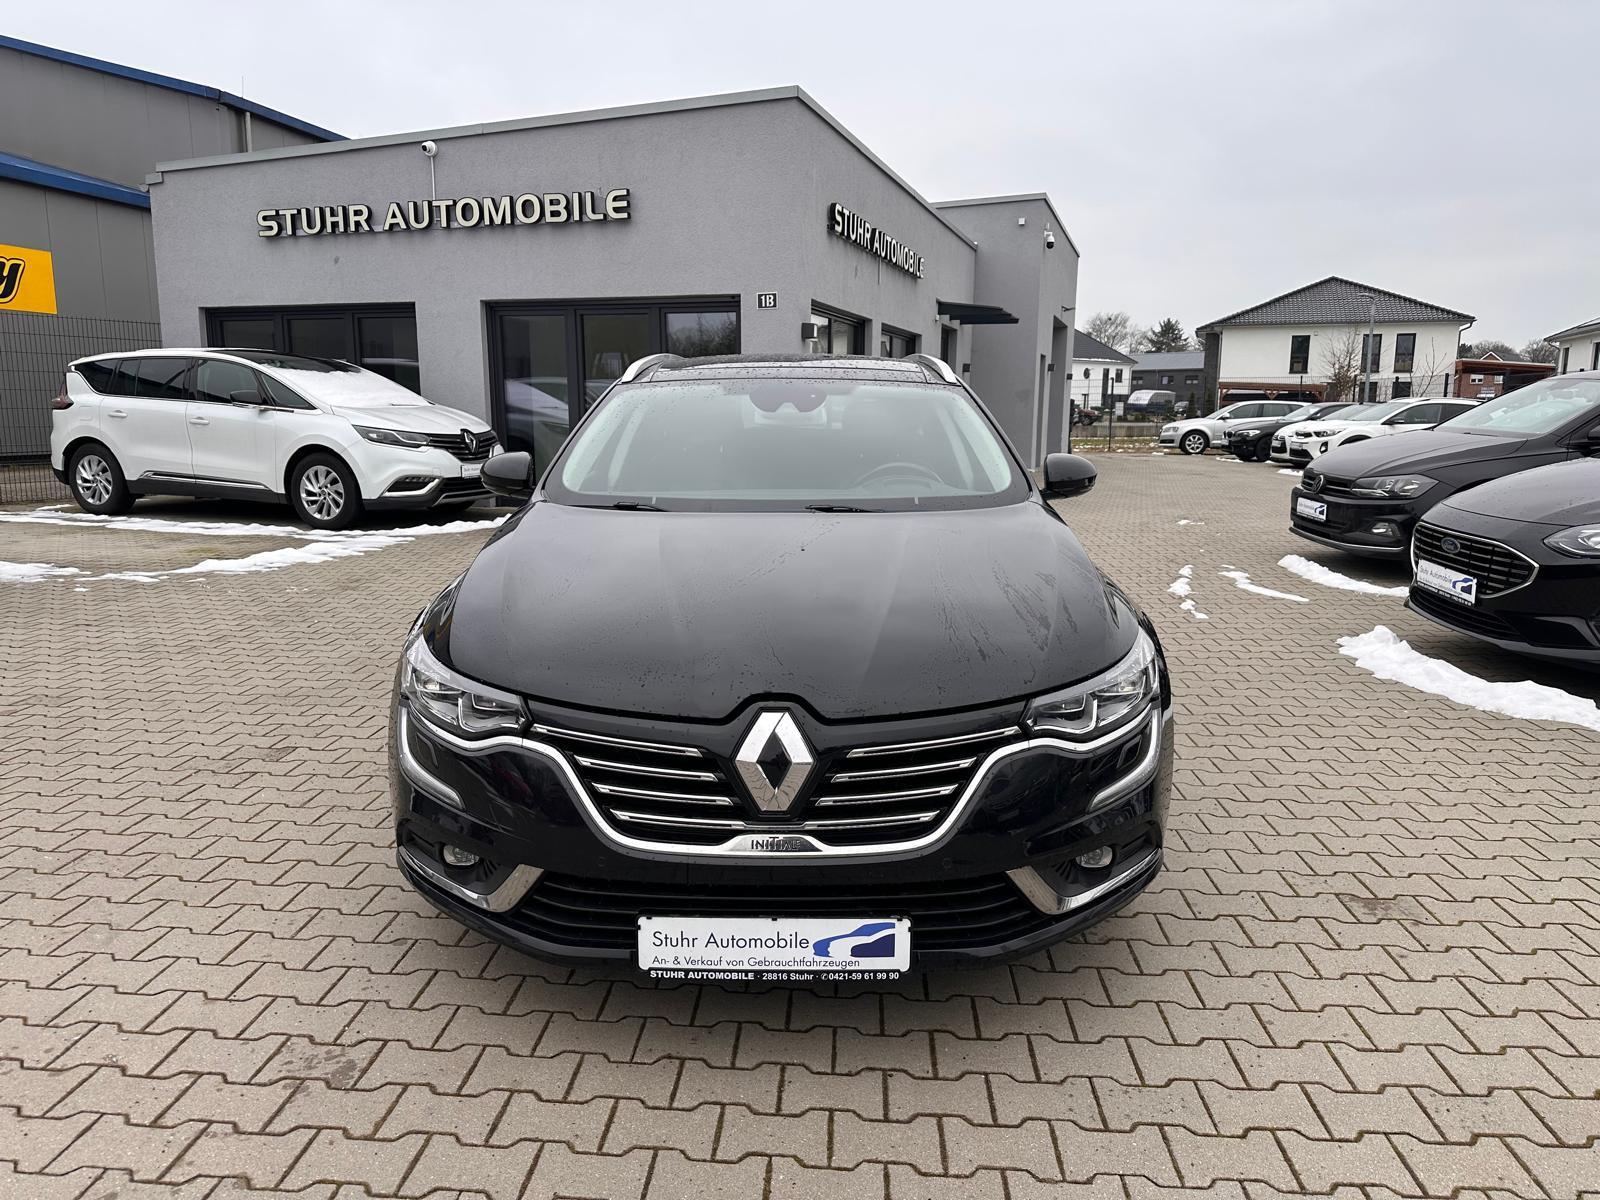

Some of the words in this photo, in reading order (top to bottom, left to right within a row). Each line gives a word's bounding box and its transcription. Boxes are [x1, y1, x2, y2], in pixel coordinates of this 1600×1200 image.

[257, 204, 371, 238] STUHR
[383, 188, 629, 231] AUTOMOBILE
[833, 203, 871, 250] STUHR
[873, 228, 925, 279] AUTOMOBILE
[760, 294, 774, 307] 1B
[652, 930, 698, 948] Stuhr
[704, 931, 810, 949] Automobile
[652, 955, 670, 966] An-
[672, 955, 681, 966] &
[684, 956, 723, 967] Verkauf
[725, 959, 744, 967] von
[747, 956, 860, 970] Gebrauchtfahrzeugen
[650, 970, 686, 979] STUHR
[687, 971, 755, 980] AUTOMOBILE
[762, 972, 788, 980] 28816
[789, 972, 814, 981] Stuhr
[864, 972, 874, 981] 61
[876, 972, 887, 981] 99
[888, 971, 899, 980] 90
